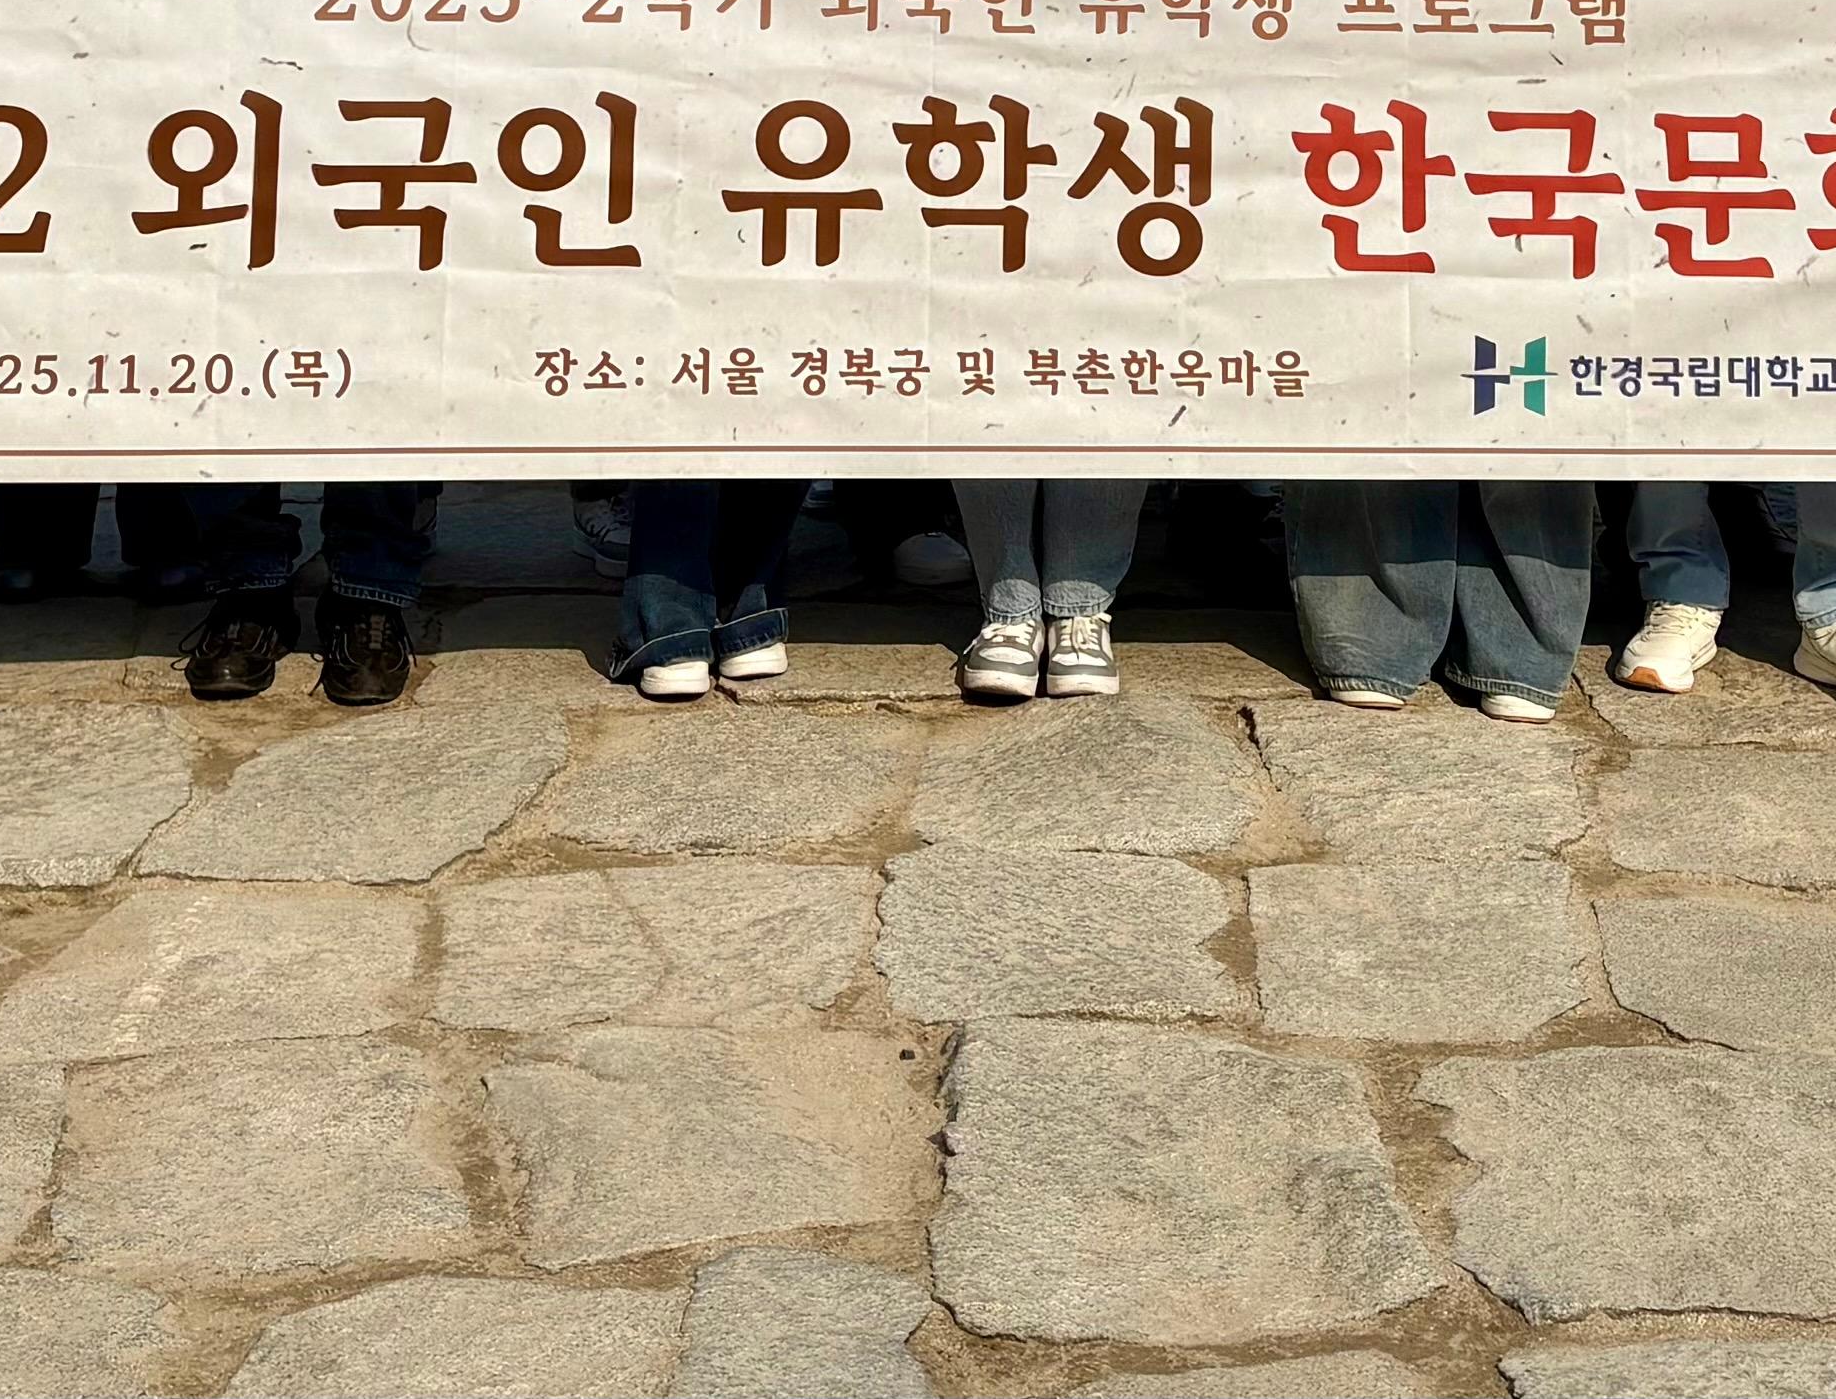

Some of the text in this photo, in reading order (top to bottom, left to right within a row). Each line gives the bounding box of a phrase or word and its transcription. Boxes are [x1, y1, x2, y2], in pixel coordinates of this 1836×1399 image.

[132, 90, 641, 271] 외국인
[722, 95, 1213, 276] 유학생
[535, 347, 1309, 397] 장소: 서울 경복궁 및 북촌한옥마을
